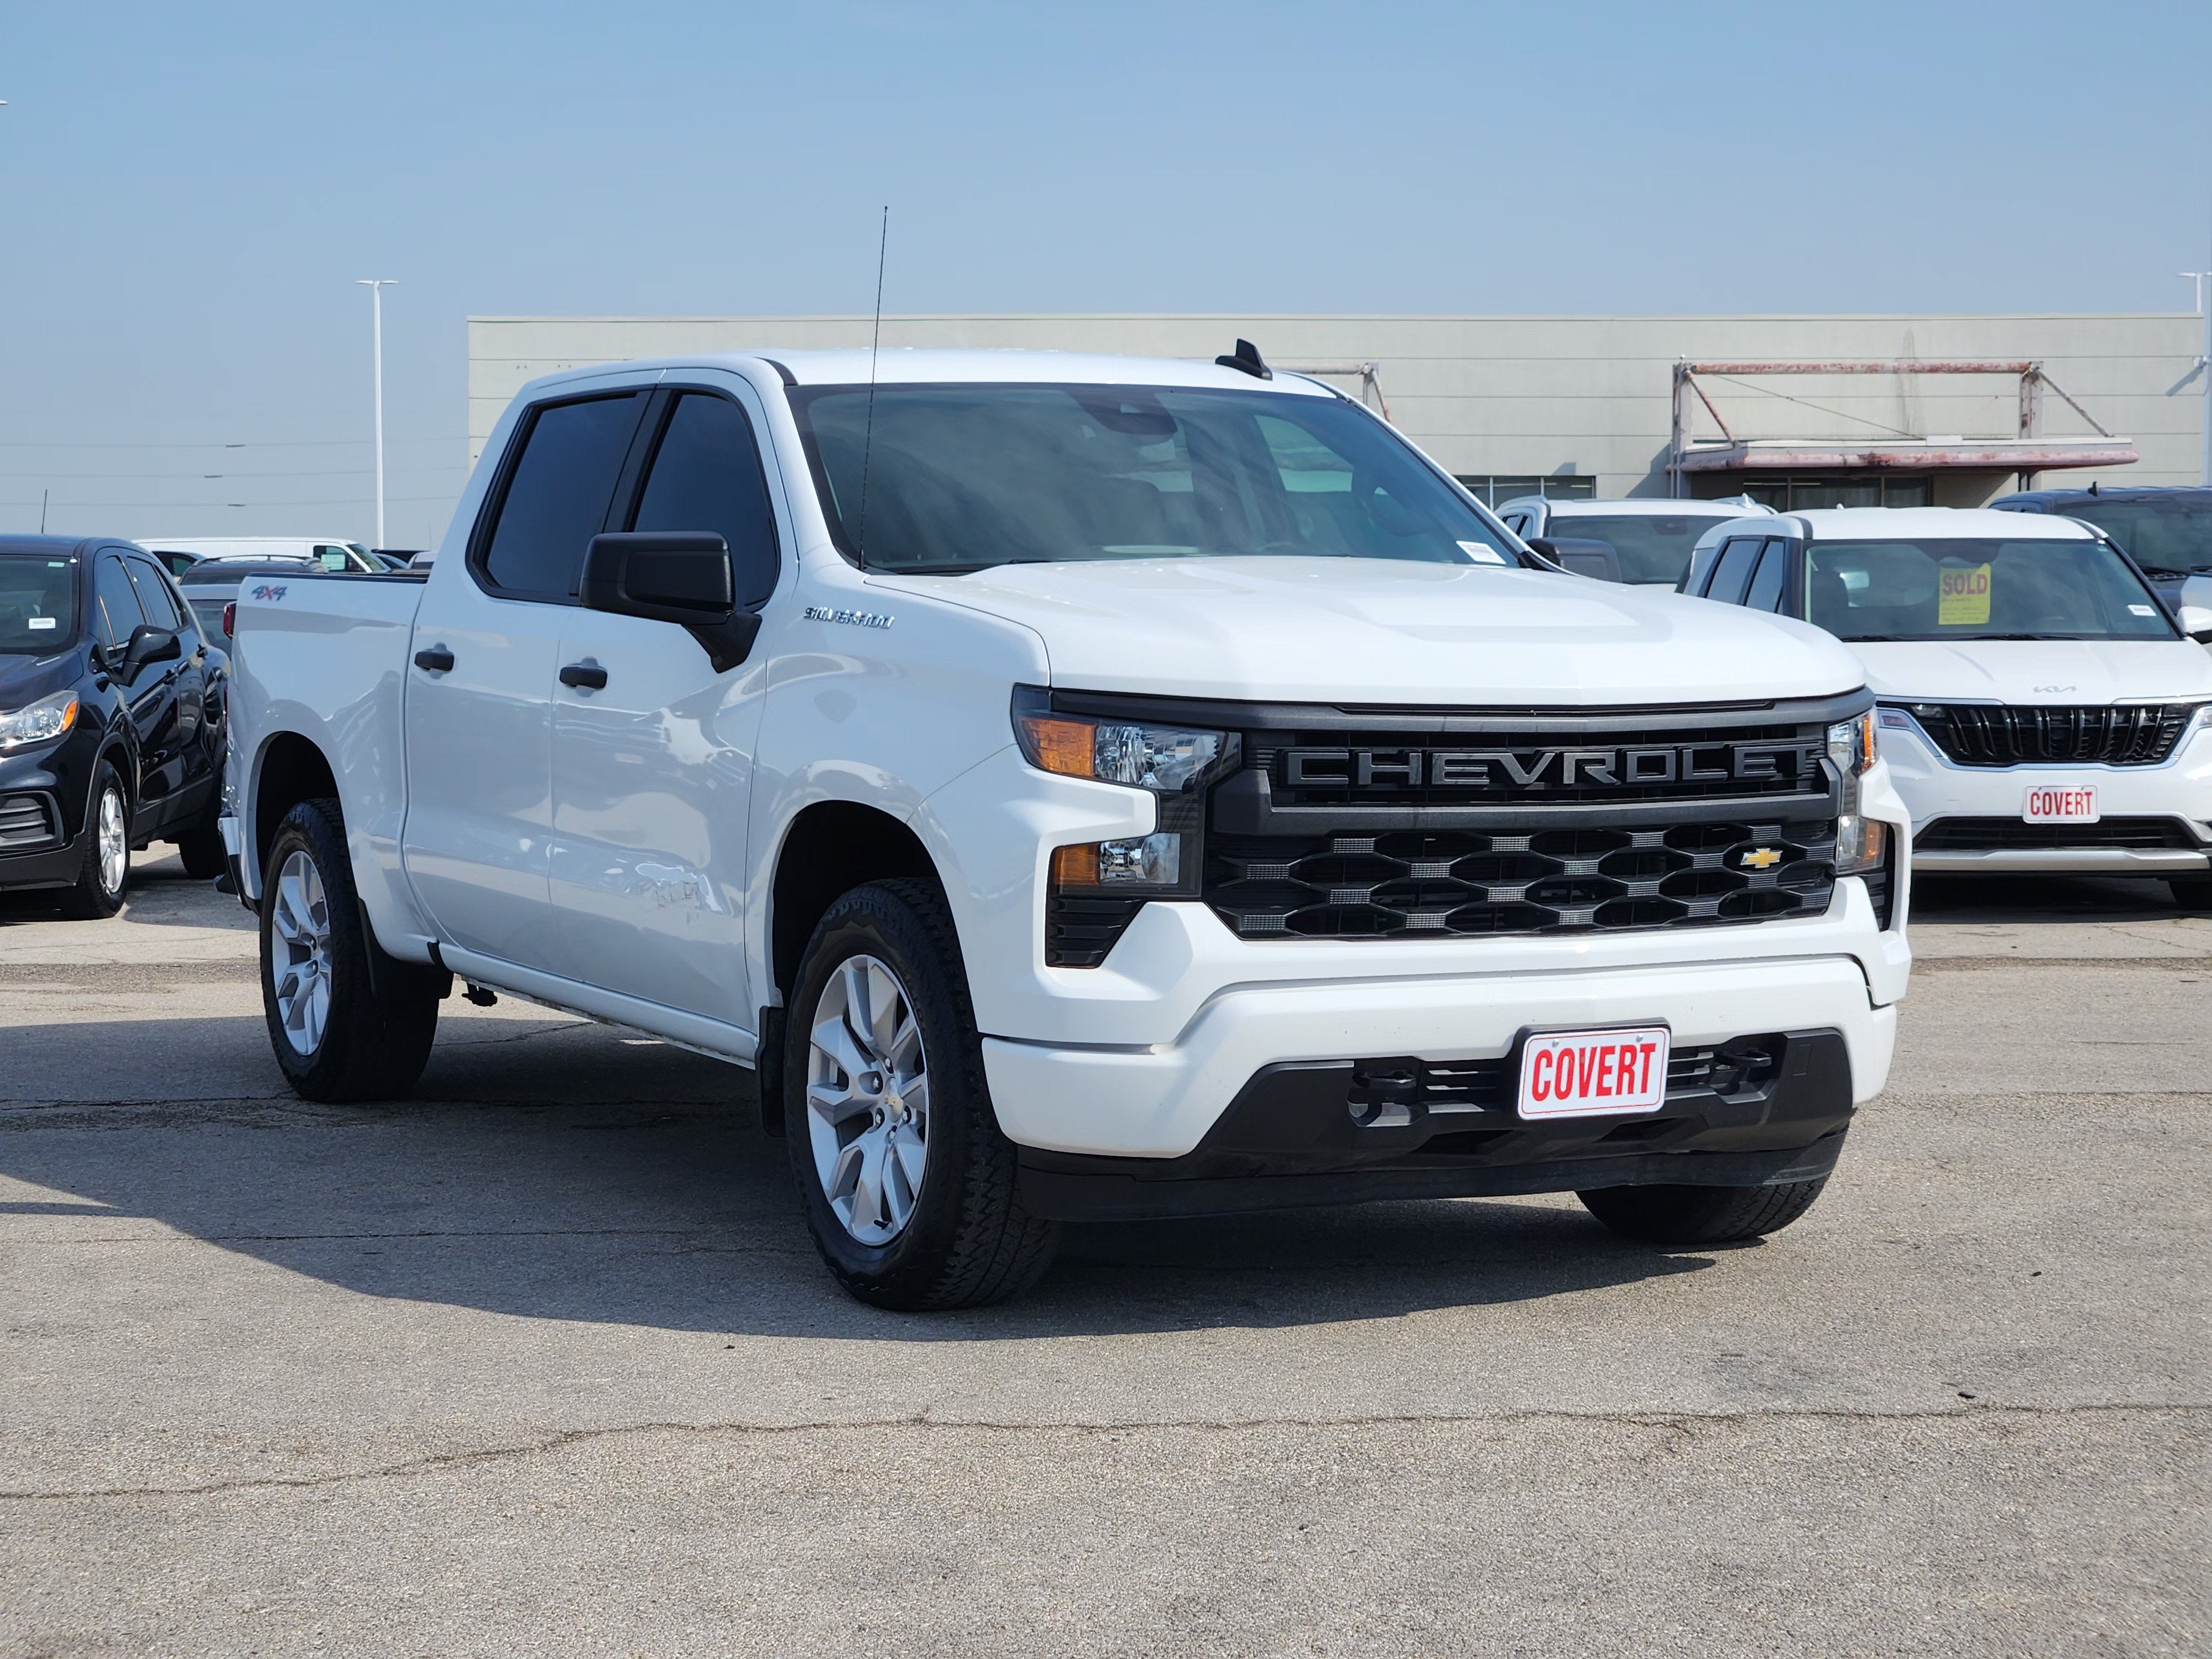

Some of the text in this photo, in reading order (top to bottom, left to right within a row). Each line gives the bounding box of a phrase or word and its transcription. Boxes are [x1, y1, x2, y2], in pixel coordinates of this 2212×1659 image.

[1942, 573, 1988, 595] SOLD
[1287, 743, 1821, 785] CHEVROLET
[2030, 791, 2093, 816] COVERT
[1532, 1042, 1657, 1102] COVERT
